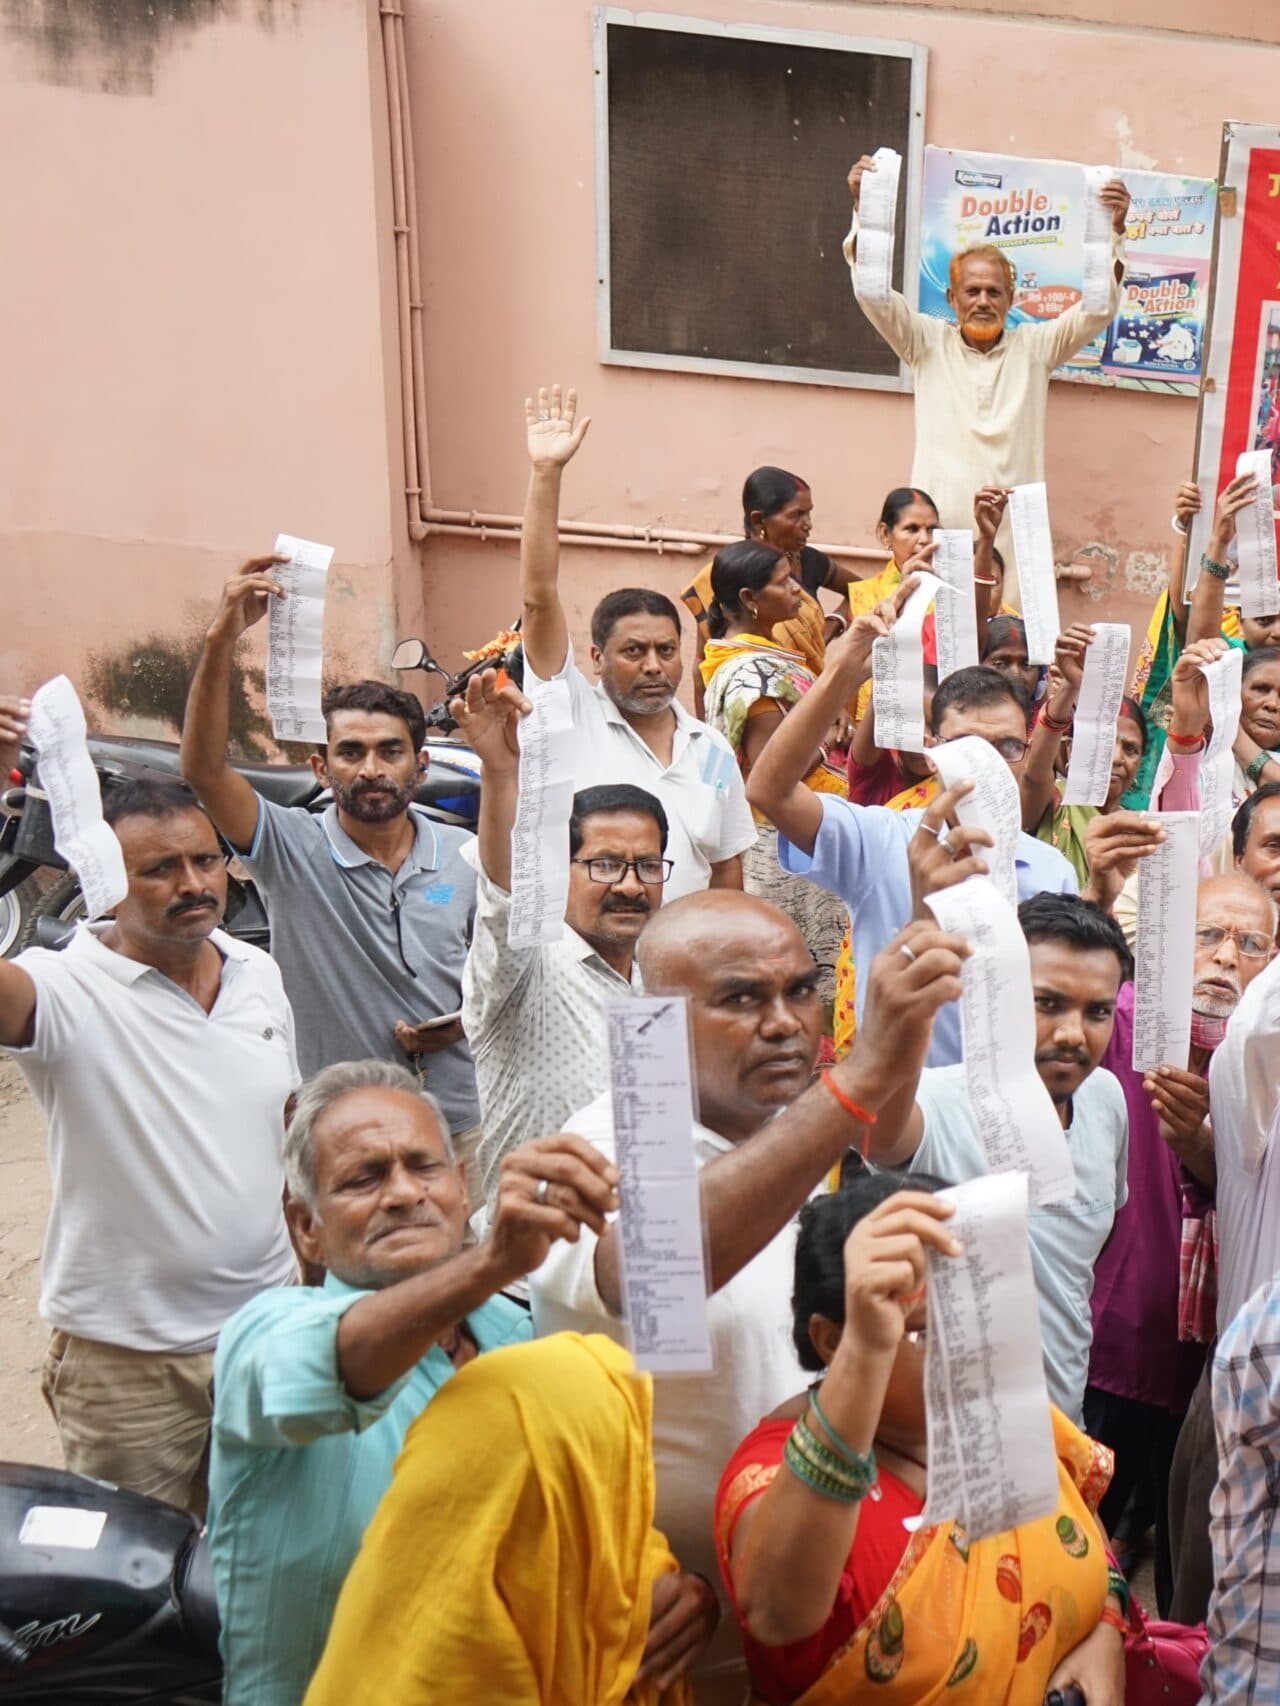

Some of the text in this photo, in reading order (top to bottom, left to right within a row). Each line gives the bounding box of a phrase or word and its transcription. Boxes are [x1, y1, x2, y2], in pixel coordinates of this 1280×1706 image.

[960, 189, 1048, 217] Double
[985, 211, 1061, 237] Action
[1128, 279, 1187, 302] Double
[1144, 298, 1195, 314] Action
